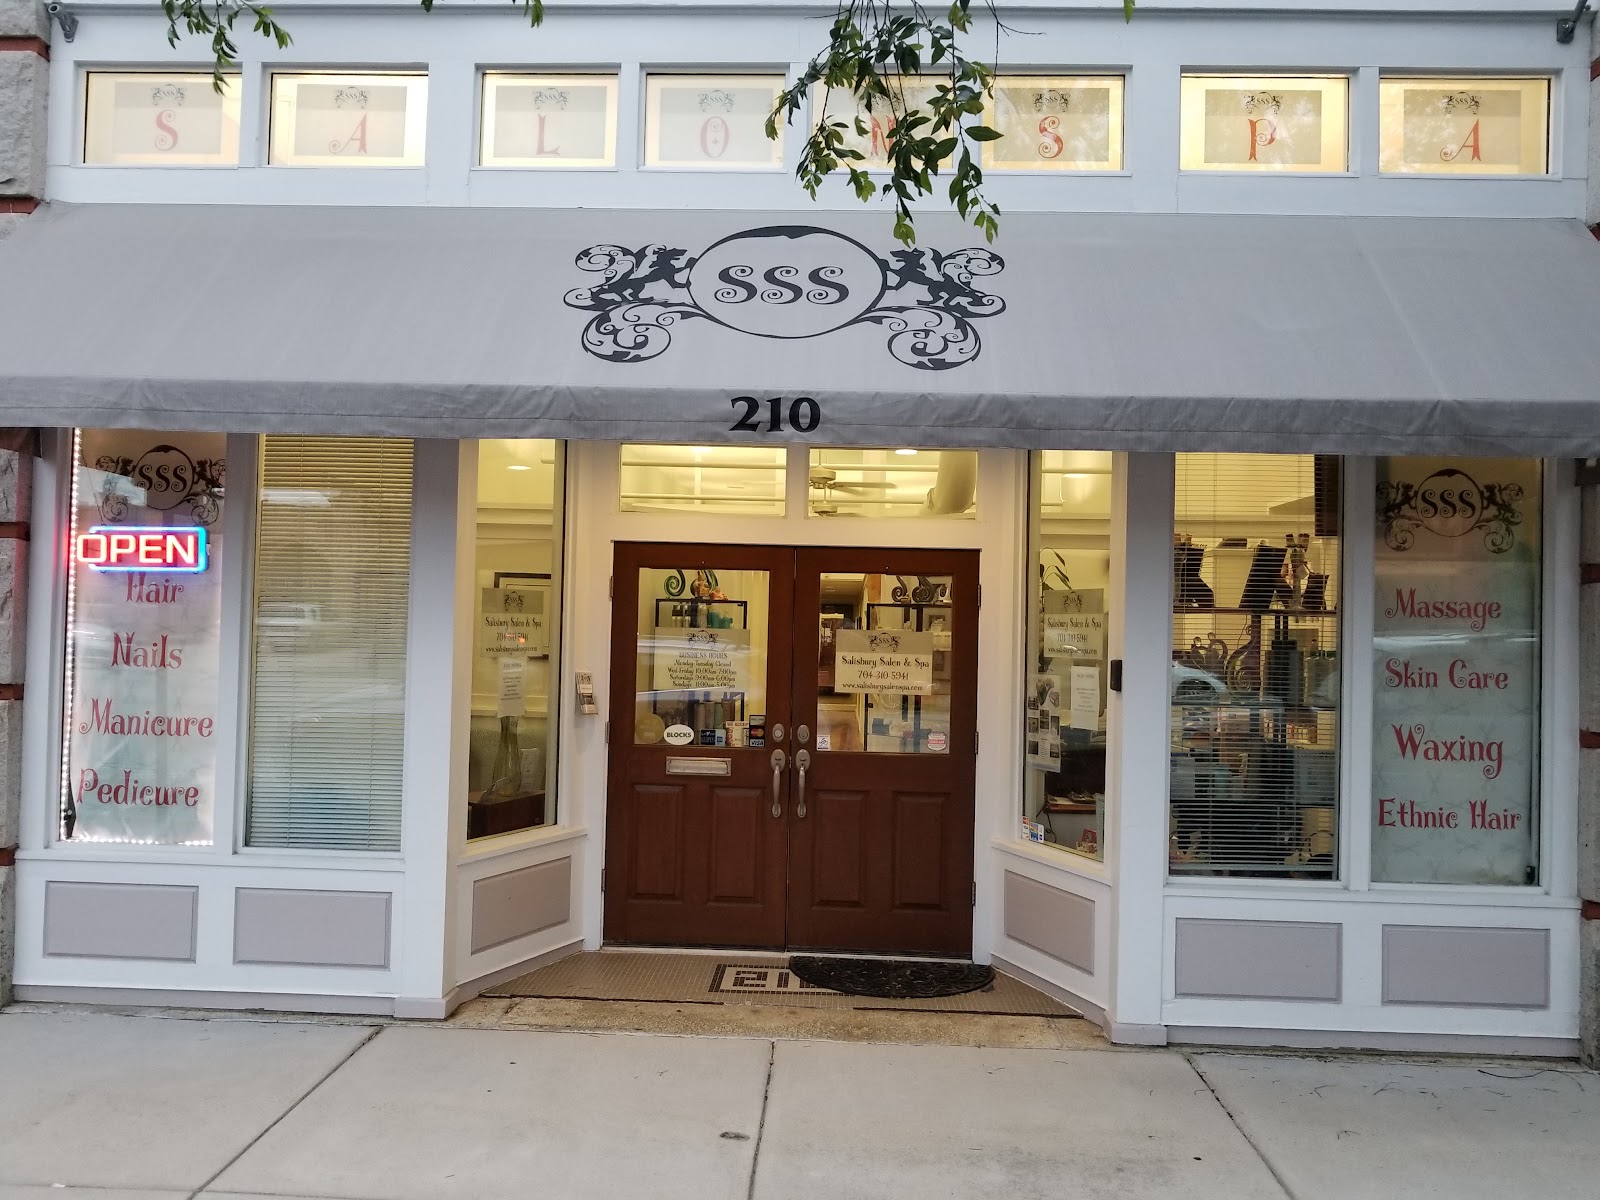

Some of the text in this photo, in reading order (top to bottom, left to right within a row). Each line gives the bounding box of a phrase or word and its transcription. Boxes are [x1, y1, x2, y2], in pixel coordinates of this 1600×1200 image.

[713, 265, 850, 305] SSS
[728, 395, 821, 433] 210
[136, 464, 187, 493] SSS
[1420, 489, 1477, 519] SSS
[76, 534, 196, 564] OPEN
[125, 571, 185, 604] Hair
[532, 617, 542, 630] Spa
[1091, 617, 1102, 631] Spa
[1384, 587, 1502, 633] Massage
[111, 631, 183, 670] Nails
[841, 655, 930, 669] Salisbury Salon & Spa
[1385, 657, 1509, 690] Skin Care
[78, 697, 214, 737] Manicure
[1391, 723, 1504, 780] Waxing
[76, 767, 200, 807] Pedicure
[1377, 797, 1522, 831] Ethnic Hair
